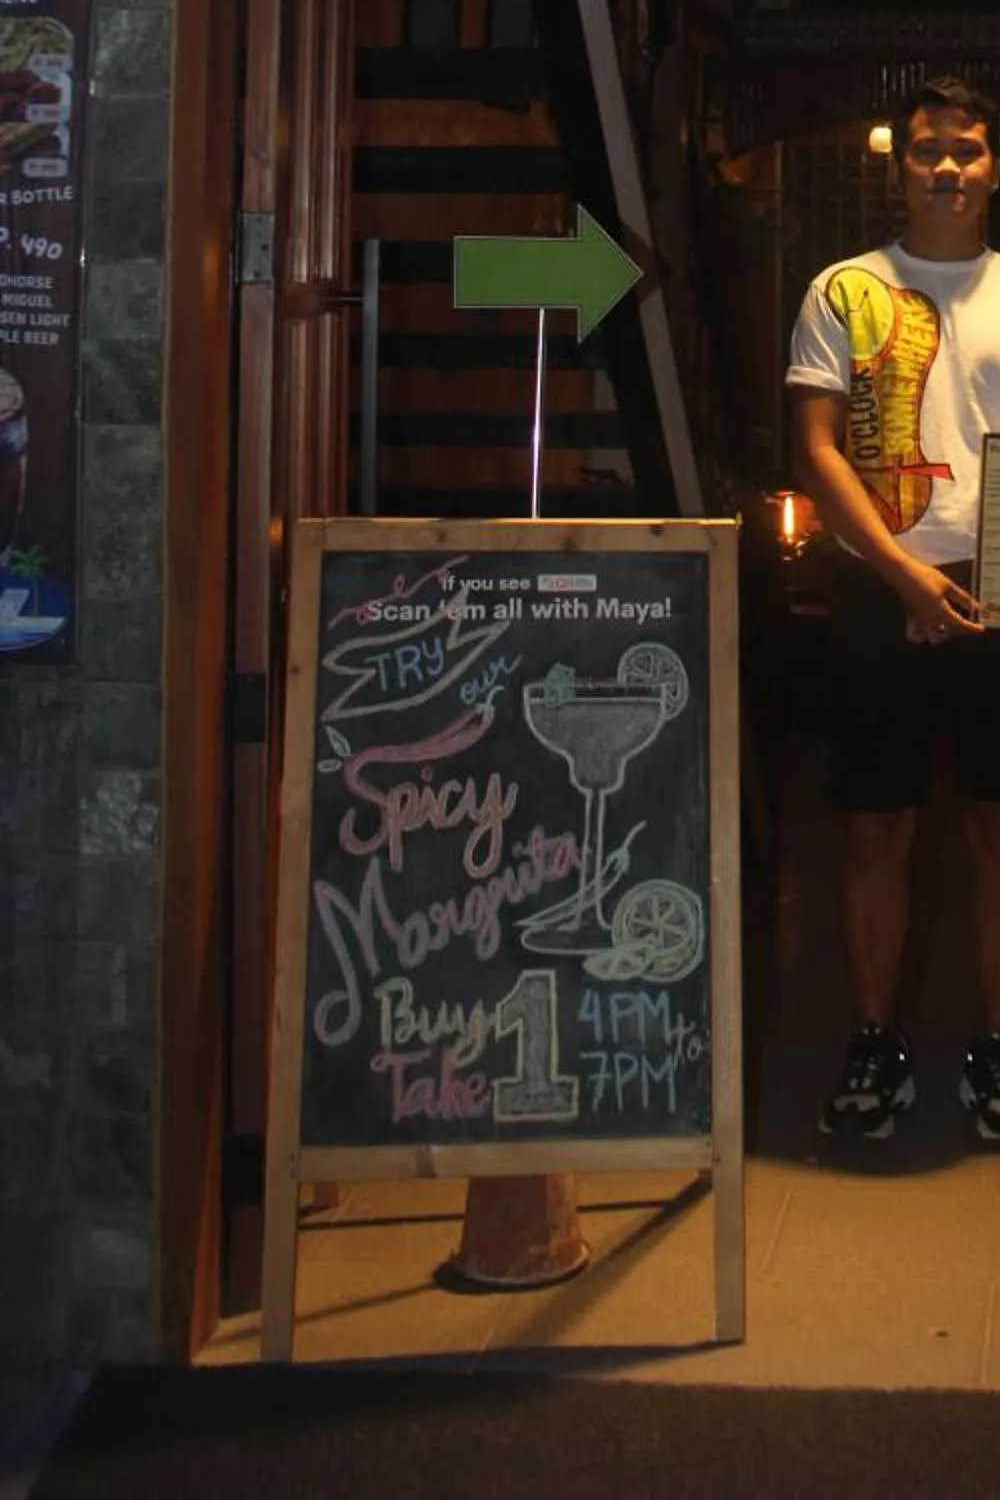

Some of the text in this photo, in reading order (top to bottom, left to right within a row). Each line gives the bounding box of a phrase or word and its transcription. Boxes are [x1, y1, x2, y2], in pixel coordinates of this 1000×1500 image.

[11, 186, 74, 206] BOTTLE
[21, 233, 63, 259] 490
[367, 602, 430, 621] Scan
[493, 598, 522, 619] all
[531, 598, 589, 619] with
[596, 598, 672, 625] Maya!
[500, 579, 531, 591] see
[338, 740, 519, 879] Spicy
[372, 969, 579, 1123] Buy 1
[577, 988, 672, 1049] 4PM
[370, 1046, 491, 1124] Take
[579, 1051, 676, 1115] 7PM
